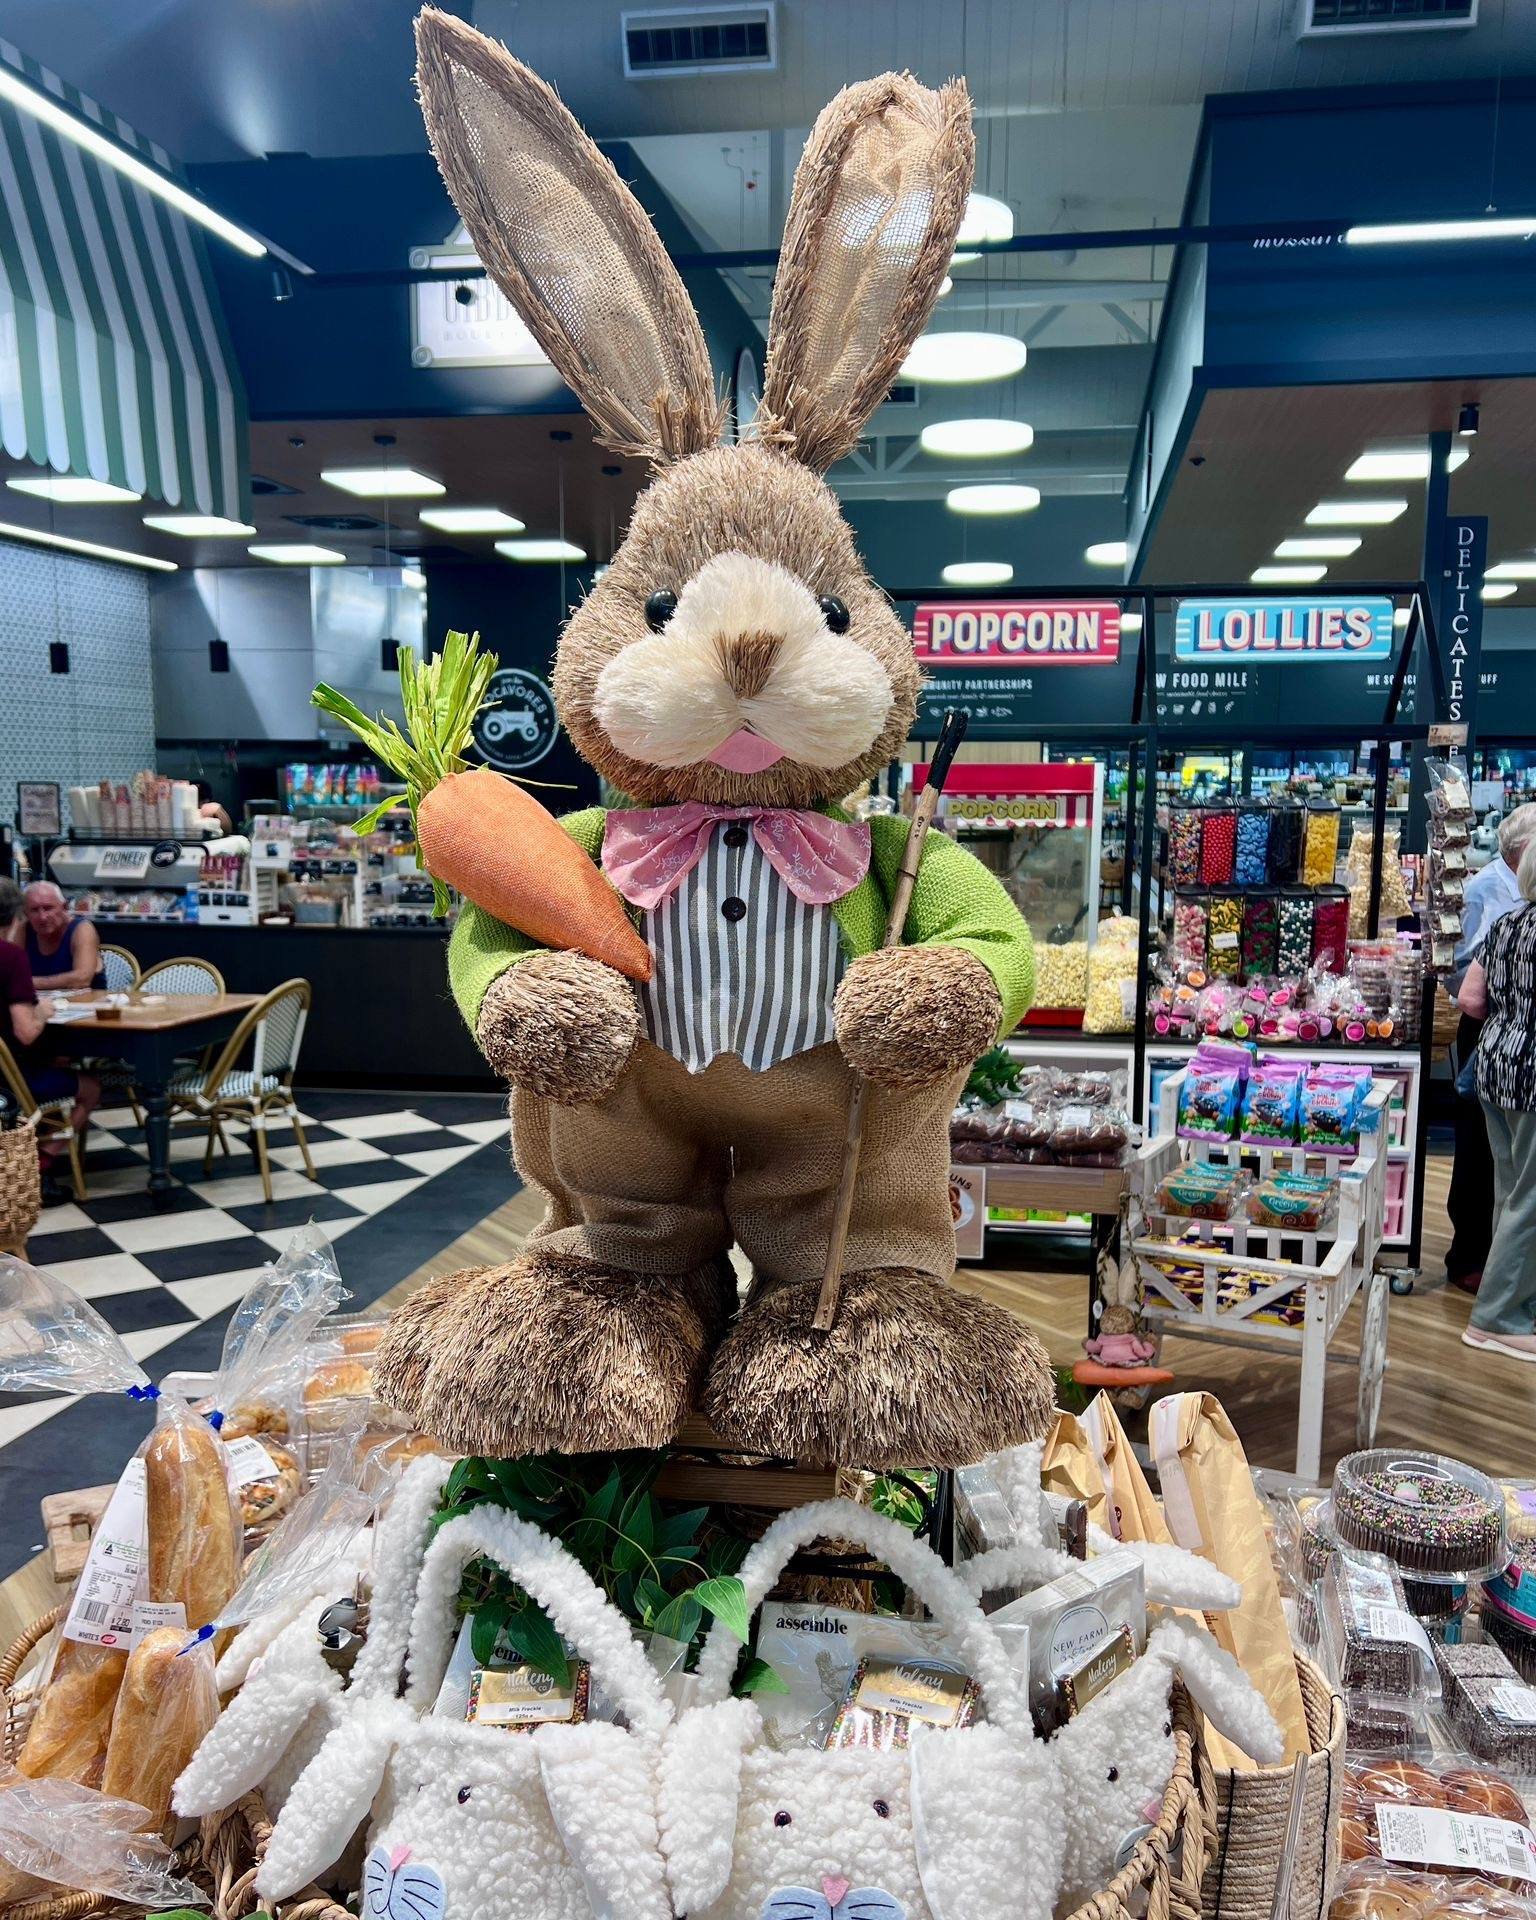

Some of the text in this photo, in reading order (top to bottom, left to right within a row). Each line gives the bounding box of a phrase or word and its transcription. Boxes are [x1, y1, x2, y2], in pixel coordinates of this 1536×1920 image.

[929, 611, 1100, 653] POPCORN
[1195, 607, 1374, 651] LOLLIES
[964, 678, 1033, 690] PARTNERSHIPS
[1172, 672, 1209, 688] FOOD
[1366, 674, 1381, 685] WE
[948, 800, 1057, 819] POPCORN
[103, 850, 148, 866] PIONEER
[775, 1616, 848, 1635] assemble
[1053, 1640, 1075, 1655] NEW
[1079, 1627, 1104, 1645] FARM
[894, 1665, 944, 1692] Maleny
[1087, 1653, 1117, 1687] Maleny
